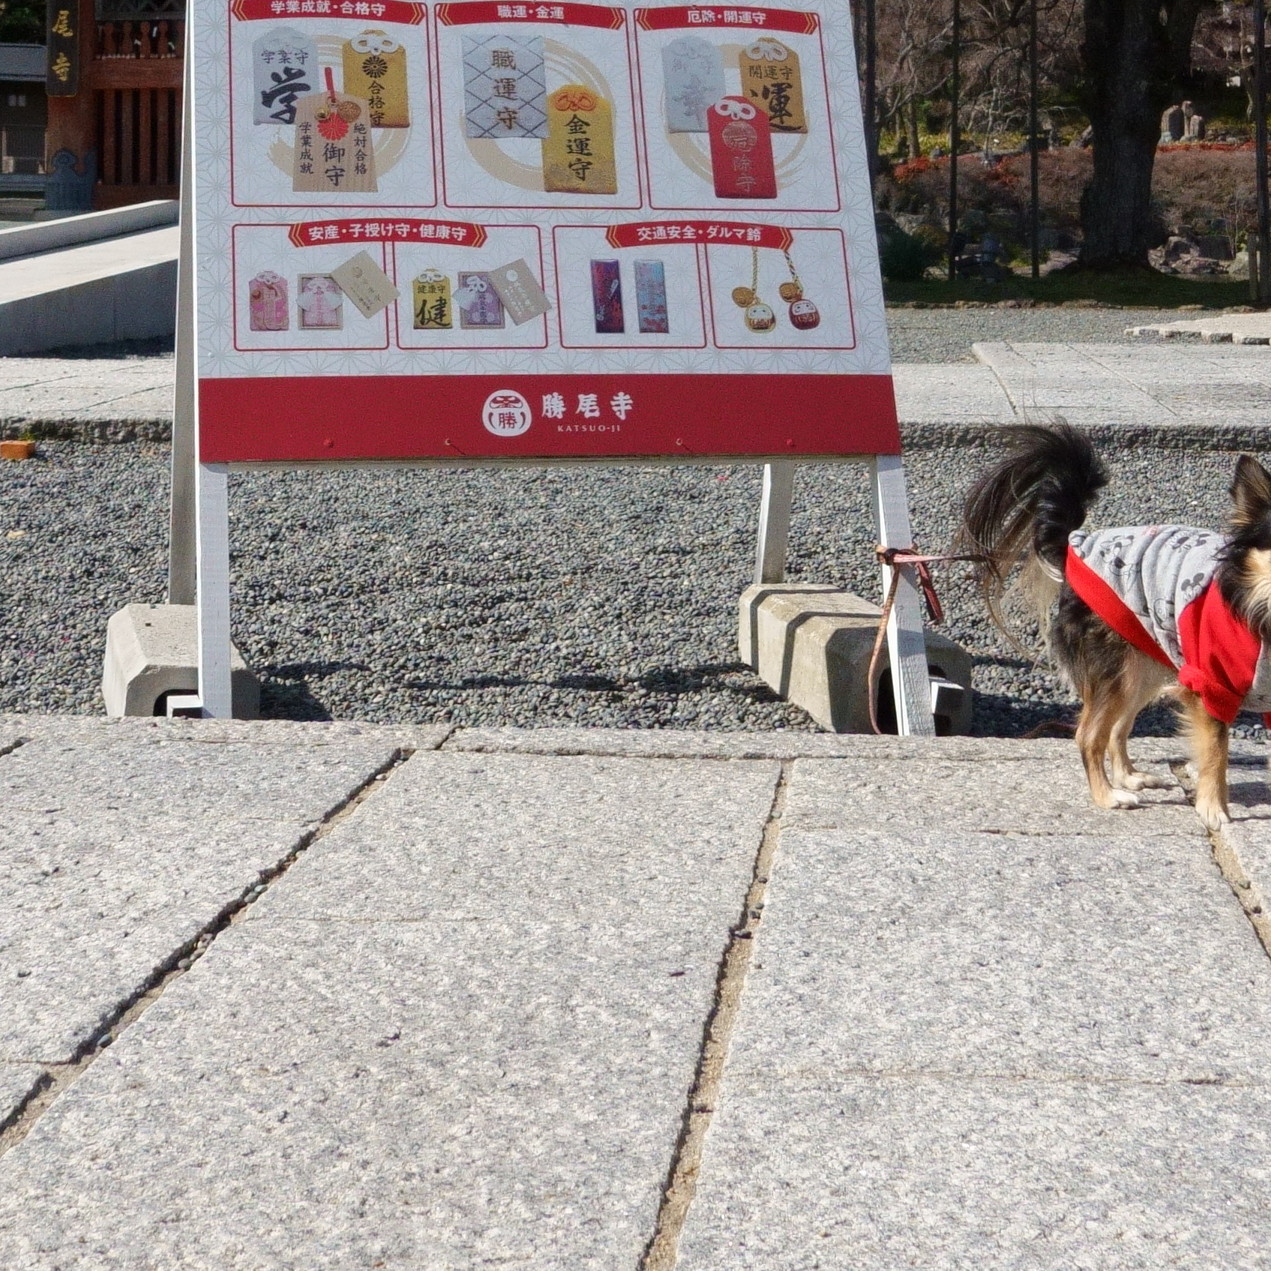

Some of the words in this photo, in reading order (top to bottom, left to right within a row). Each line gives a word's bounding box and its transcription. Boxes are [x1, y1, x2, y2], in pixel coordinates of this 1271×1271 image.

[271, 0, 386, 17] 学業成就・合格守
[497, 4, 565, 20] 職運・金運
[687, 9, 767, 25] 厄除・開運守
[261, 50, 309, 65] 学業守
[748, 65, 793, 79] 開運守
[261, 66, 311, 124] 学
[491, 49, 519, 130] 職運守
[368, 79, 385, 127] 合格守
[299, 122, 314, 175] 学業成就
[353, 123, 368, 175] 絶対合格
[564, 114, 593, 182] 金運守
[322, 142, 346, 187] 御守
[308, 223, 467, 242] 安産・子授け守・健康守
[636, 225, 762, 243] 交通安全・ダルマ鈴
[417, 285, 445, 294] 健康守
[416, 296, 451, 329] 健
[541, 391, 633, 420] 勝尾寺
[498, 411, 517, 430] 勝
